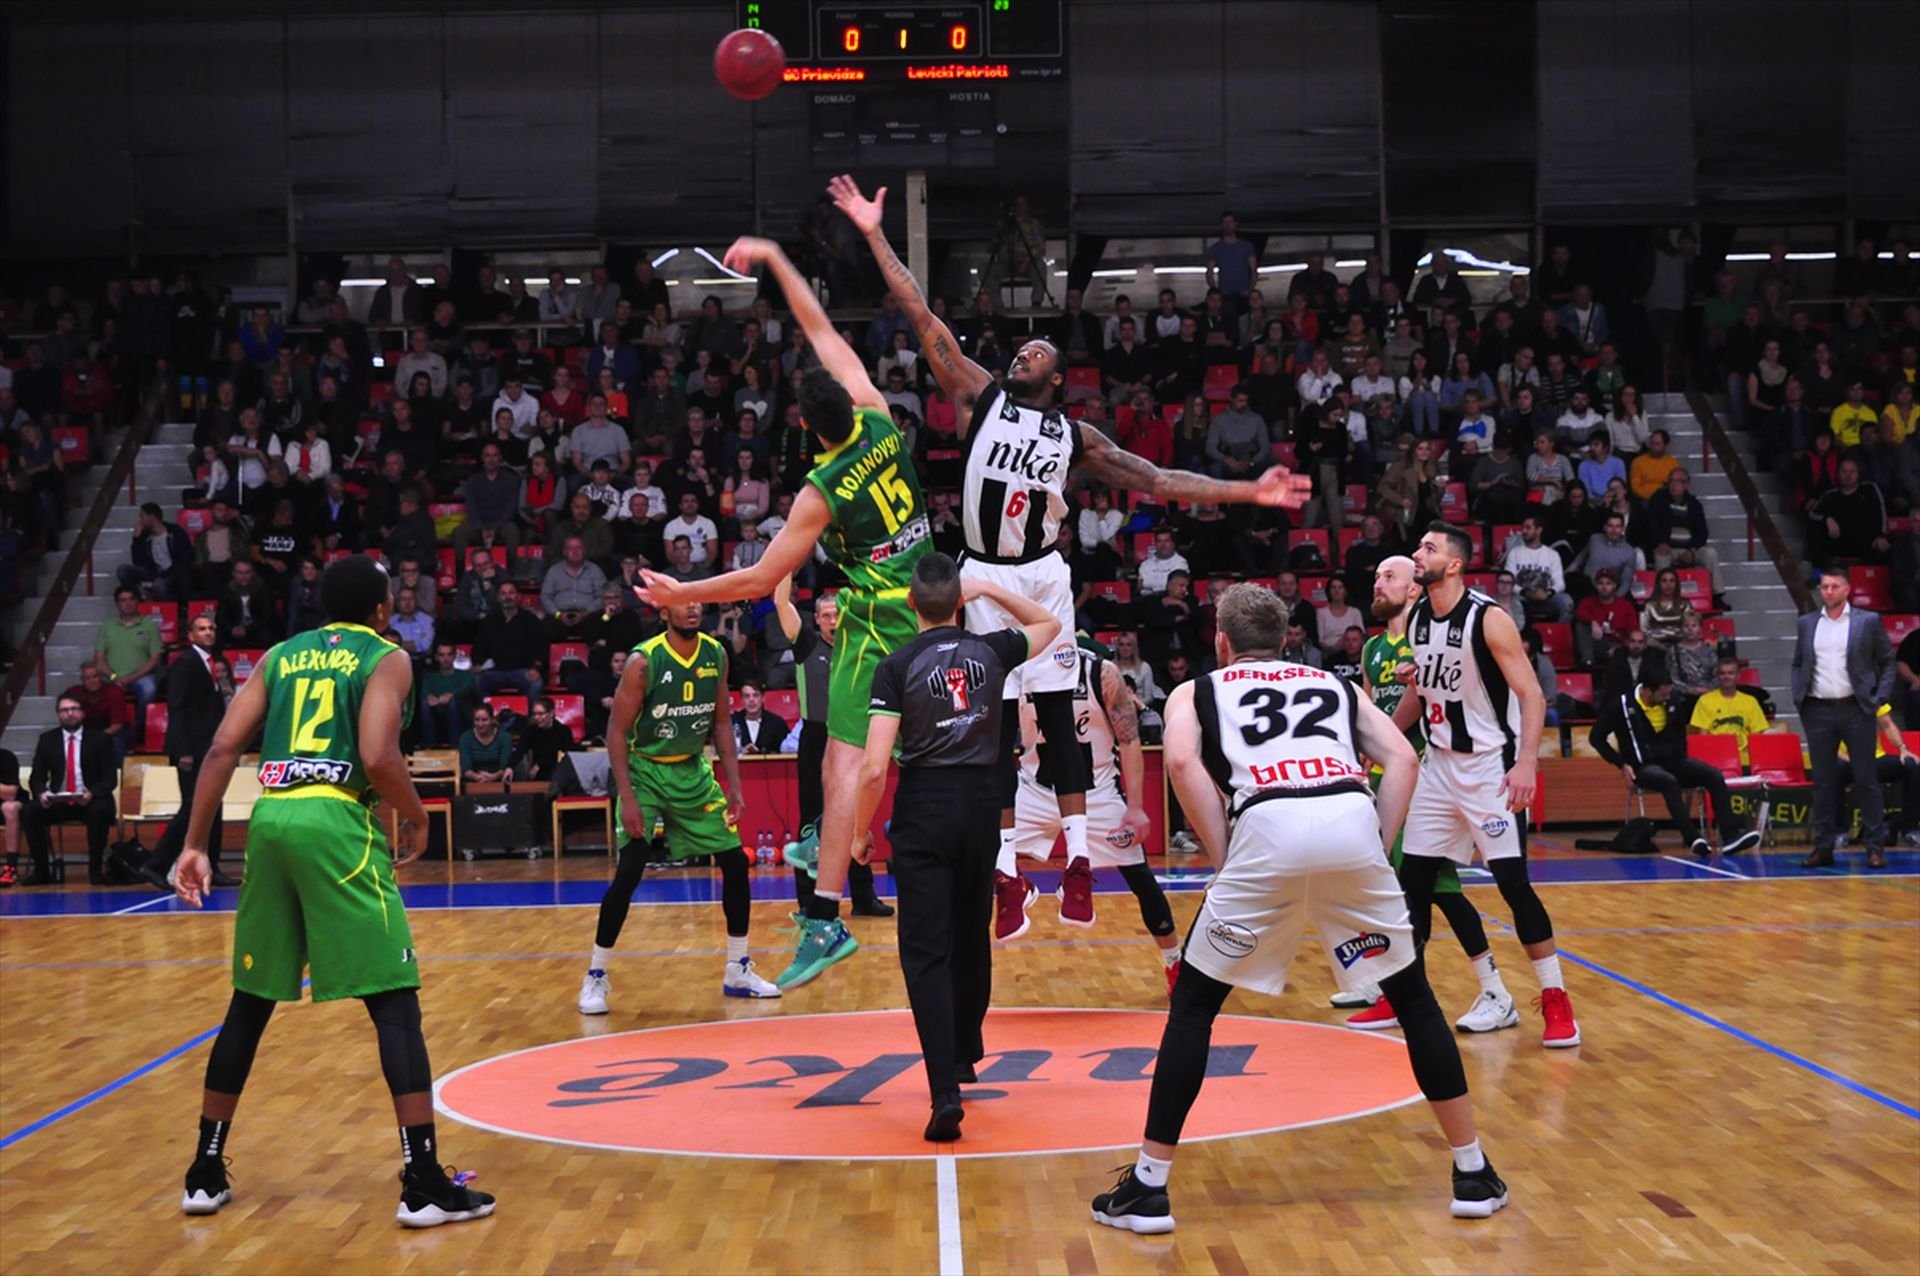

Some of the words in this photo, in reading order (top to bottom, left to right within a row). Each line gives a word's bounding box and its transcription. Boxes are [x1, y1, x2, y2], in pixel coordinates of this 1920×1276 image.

[845, 29, 860, 51] 0
[900, 29, 907, 49] 1
[952, 27, 967, 50] 0
[956, 65, 1009, 78] Patrioti
[949, 92, 991, 102] HOSTIA
[986, 438, 1061, 484] niké
[867, 462, 914, 536] 15
[1006, 491, 1028, 518] 6
[1223, 667, 1327, 683] DERKSEN
[683, 680, 695, 702] 0
[289, 677, 336, 754] 12
[1238, 687, 1340, 747] 32
[1429, 703, 1445, 725] 8
